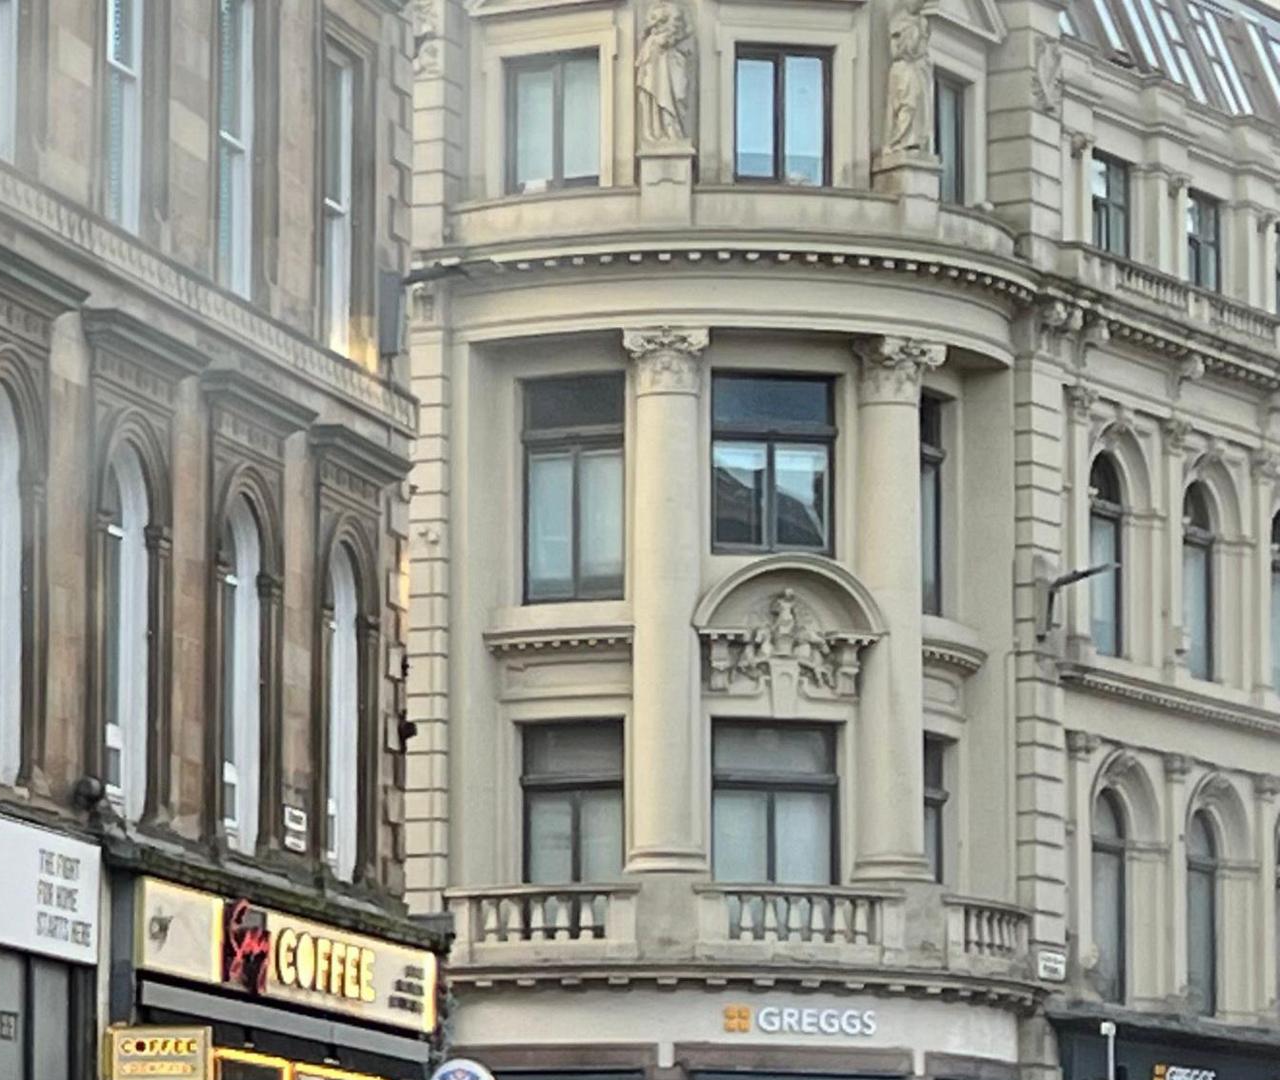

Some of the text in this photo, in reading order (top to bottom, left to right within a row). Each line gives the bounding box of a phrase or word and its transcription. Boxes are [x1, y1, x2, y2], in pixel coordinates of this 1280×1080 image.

[277, 928, 376, 1003] COFFEE
[758, 1006, 877, 1035] GREGGS
[120, 1037, 198, 1055] COFFEE
